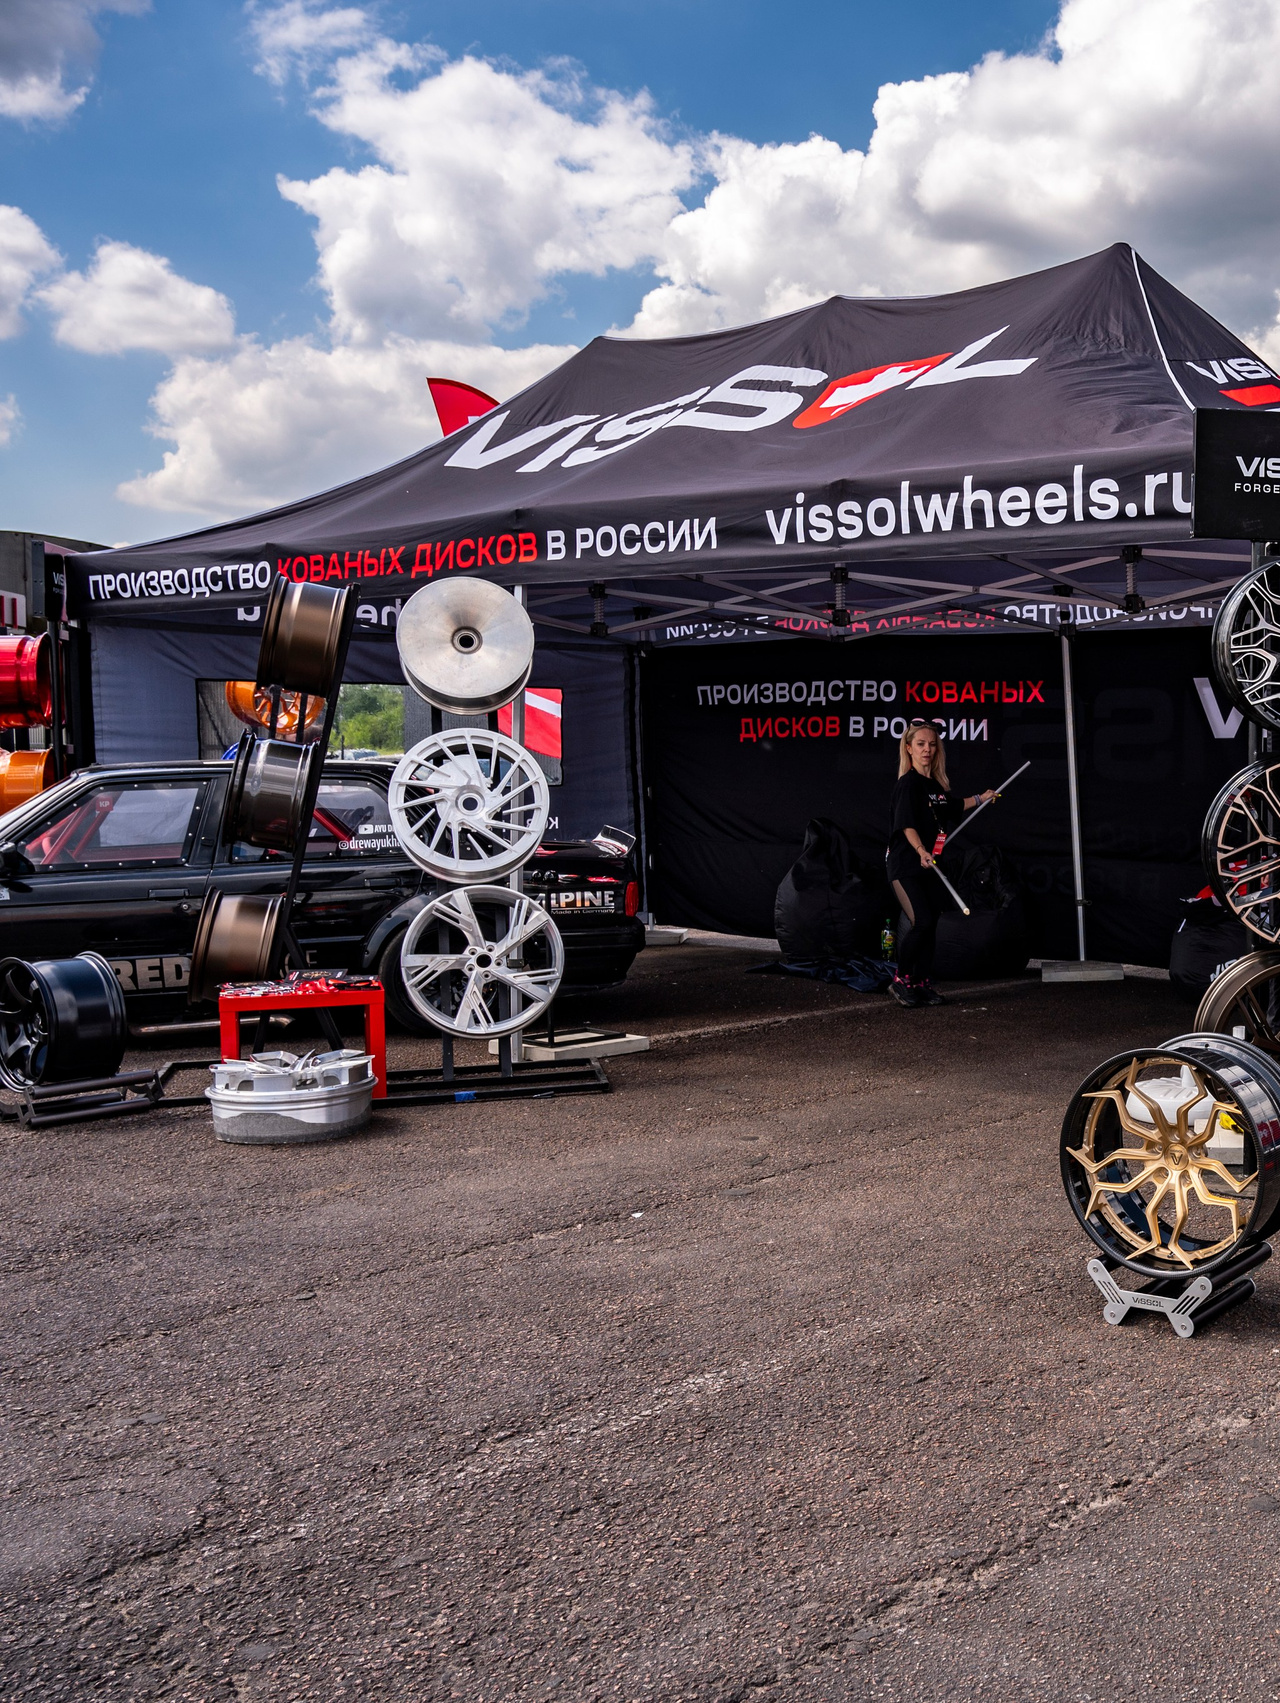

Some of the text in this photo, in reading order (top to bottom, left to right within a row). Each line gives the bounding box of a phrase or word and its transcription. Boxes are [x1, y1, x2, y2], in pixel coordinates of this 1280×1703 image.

[765, 464, 1193, 546] vissolwheels.ru
[88, 516, 718, 599] ПРОИЗВОДСТВО КОВАНЫХ ДИСКОВ В РОССИИ
[697, 680, 1046, 706] ПРОИЗВОДСТВО КОВАНЫХ
[739, 716, 841, 743] ДИСКОВ
[849, 716, 865, 738] В
